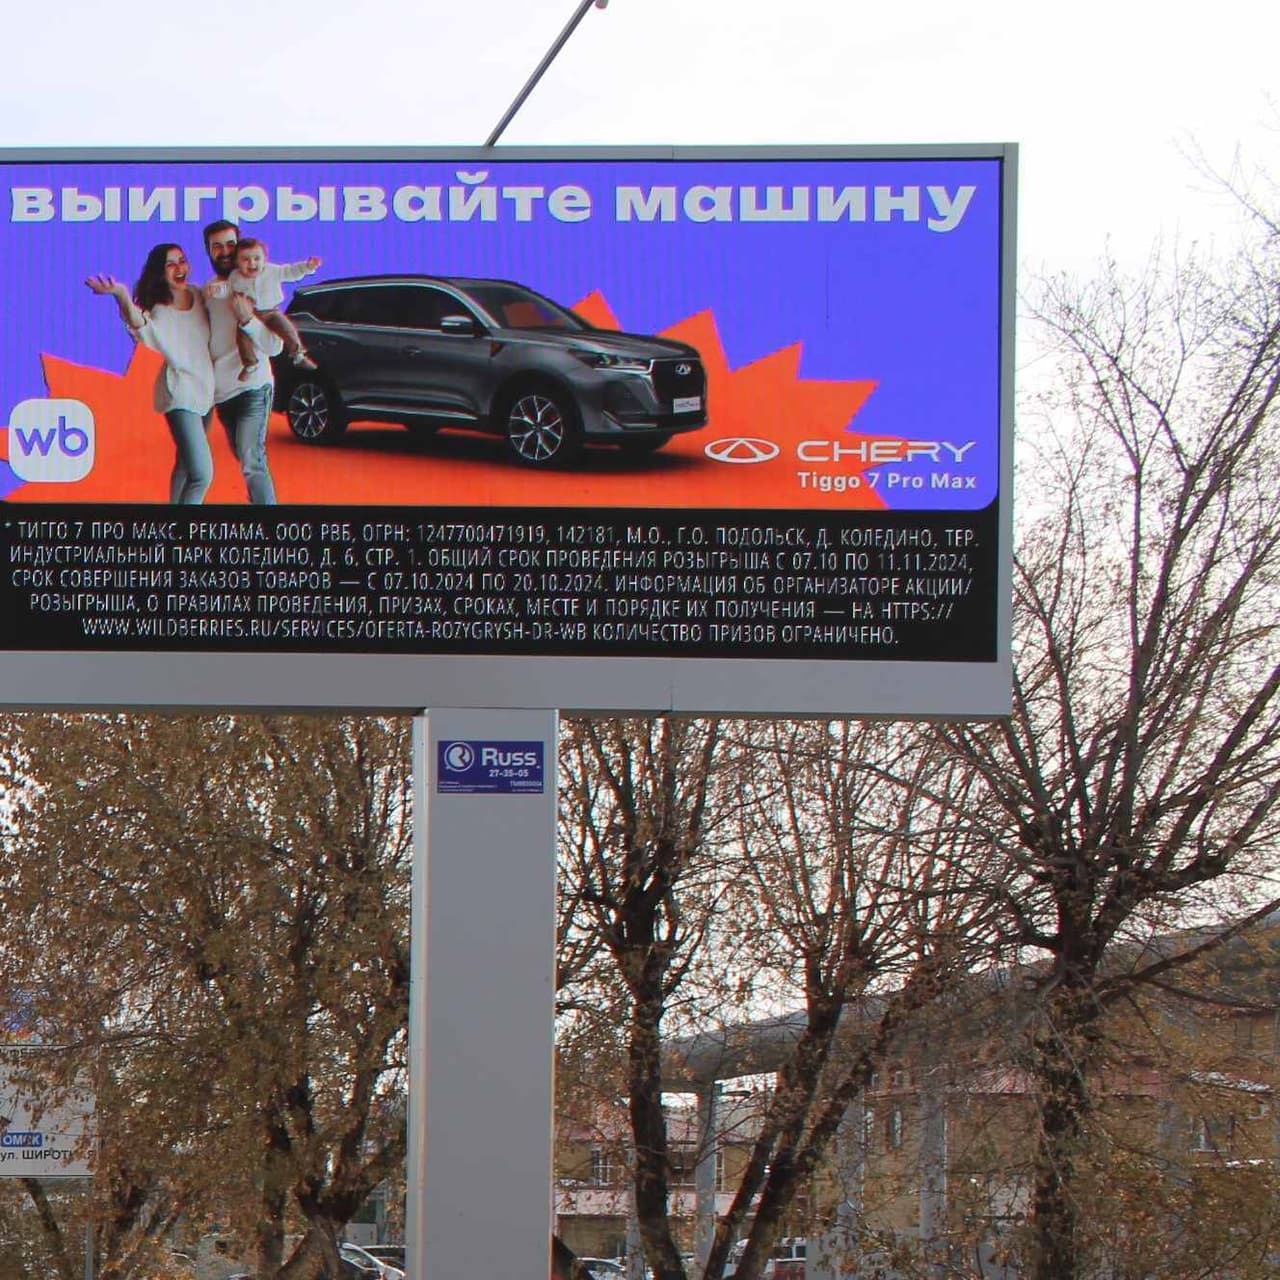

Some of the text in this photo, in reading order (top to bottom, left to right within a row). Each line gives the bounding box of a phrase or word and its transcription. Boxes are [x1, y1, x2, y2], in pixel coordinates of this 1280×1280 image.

[10, 171, 977, 232] выигрывайте машину
[15, 416, 89, 457] wb
[797, 440, 977, 462] CHERY
[797, 472, 977, 492] Tiggo 7 Pro Max
[17, 521, 68, 540] ТИГГО
[74, 522, 84, 539] 7
[91, 522, 124, 540] ПРО
[132, 522, 183, 540] МАКС.
[190, 522, 269, 541] РЕКЛАМА.
[276, 523, 313, 542] ООО
[320, 523, 357, 543] РВБ,
[363, 524, 411, 543] ОГРН:
[677, 526, 709, 545] Г.О.
[716, 527, 811, 548] ПОДОЛЬСК,
[840, 528, 938, 550] КОЛЕДИНО,
[945, 529, 980, 548] ТЕР.
[9, 543, 165, 566] ИНДУСТРИАЛЬНЫЙ
[173, 546, 212, 564] ПАРК
[219, 547, 314, 568] КОЛЕДИНО,
[365, 548, 400, 566] СТР.
[428, 545, 491, 569] ОБЩИЙ
[498, 549, 540, 568] СРОК
[546, 550, 657, 570] ПРОВЕДЕНИЯ
[776, 552, 786, 571] С
[792, 553, 837, 571] 07.10
[845, 553, 869, 572] ПО
[878, 553, 974, 574] 11.11.2024,
[11, 569, 54, 588] СРОК
[60, 570, 173, 589] СОВЕРШЕНИЯ
[179, 571, 251, 589] ЗАКАЗОВ
[256, 571, 332, 590] ТОВАРОВ
[367, 572, 377, 590] С
[384, 572, 474, 591] 07.10.2024
[482, 573, 505, 591] ПО
[513, 574, 609, 593] 20.10.2024.
[615, 574, 736, 596] ИНФОРМАЦИЯ
[743, 576, 766, 594] ОБ
[773, 577, 900, 596] ОРГАНИЗАТОРЕ
[905, 578, 973, 599] АКЦИИ/
[147, 594, 159, 613] О
[167, 595, 251, 613] ПРАВИЛАХ
[257, 596, 373, 617] ПРОВЕДЕНИЯ,
[379, 597, 448, 617] ПРИЗАХ,
[453, 597, 520, 618] СРОКАХ,
[526, 598, 580, 617] МЕСТЕ
[586, 600, 597, 617] И
[606, 600, 680, 620] ПОРЯДКЕ
[687, 600, 708, 618] ИХ
[715, 600, 815, 619] ПОЛУЧЕНИЯ
[852, 601, 874, 619] НА
[882, 602, 954, 621] HTTPS://
[593, 623, 702, 642] КОЛИЧЕСТВО
[709, 624, 776, 643] ПРИЗОВ
[781, 626, 899, 645] ОГРАНИЧЕНО.
[481, 748, 537, 766] Russ
[0, 1150, 94, 1161] ул. ШИРОТЯ
